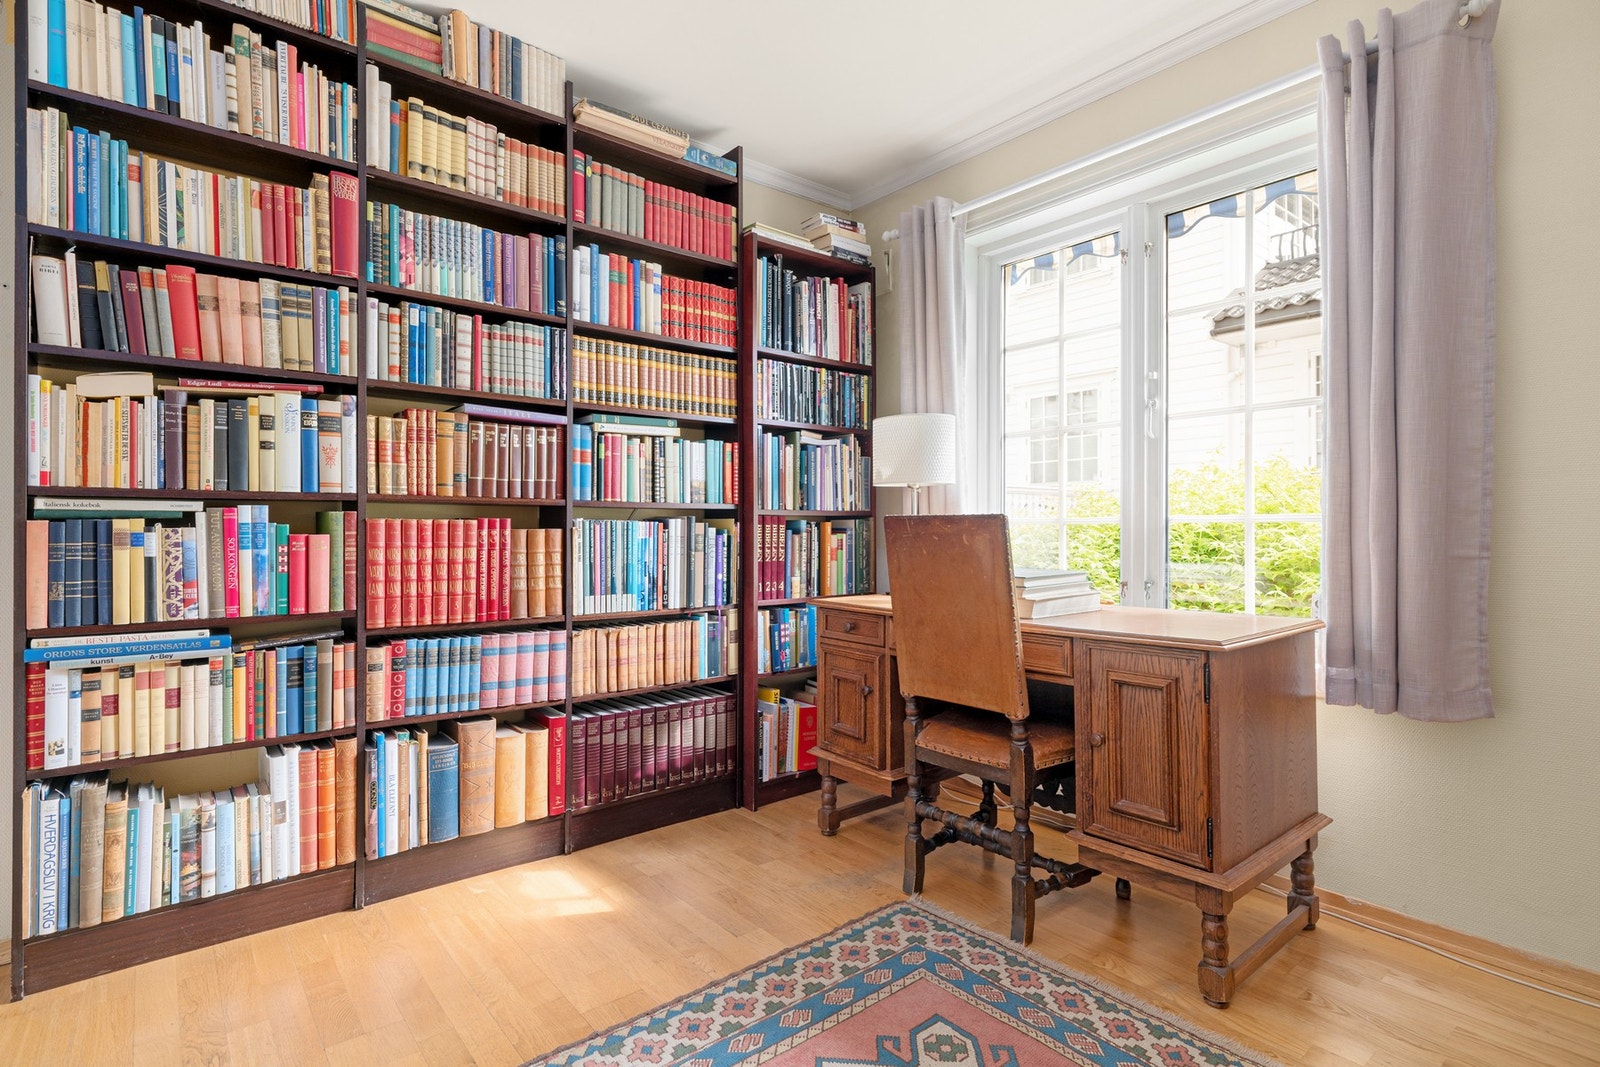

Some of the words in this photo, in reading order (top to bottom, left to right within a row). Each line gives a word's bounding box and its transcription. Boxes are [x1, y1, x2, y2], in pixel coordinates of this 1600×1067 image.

[630, 113, 650, 126] PAUL
[228, 538, 236, 589] SOLKONGEN
[369, 583, 383, 596] LAND
[86, 636, 115, 644] BESTE
[43, 649, 85, 659] ORIONS
[88, 647, 123, 656] STORE
[126, 641, 202, 653] VERDENSATLAS
[44, 814, 56, 891] HVERDAGSLIV
[43, 902, 55, 929] KRIG
